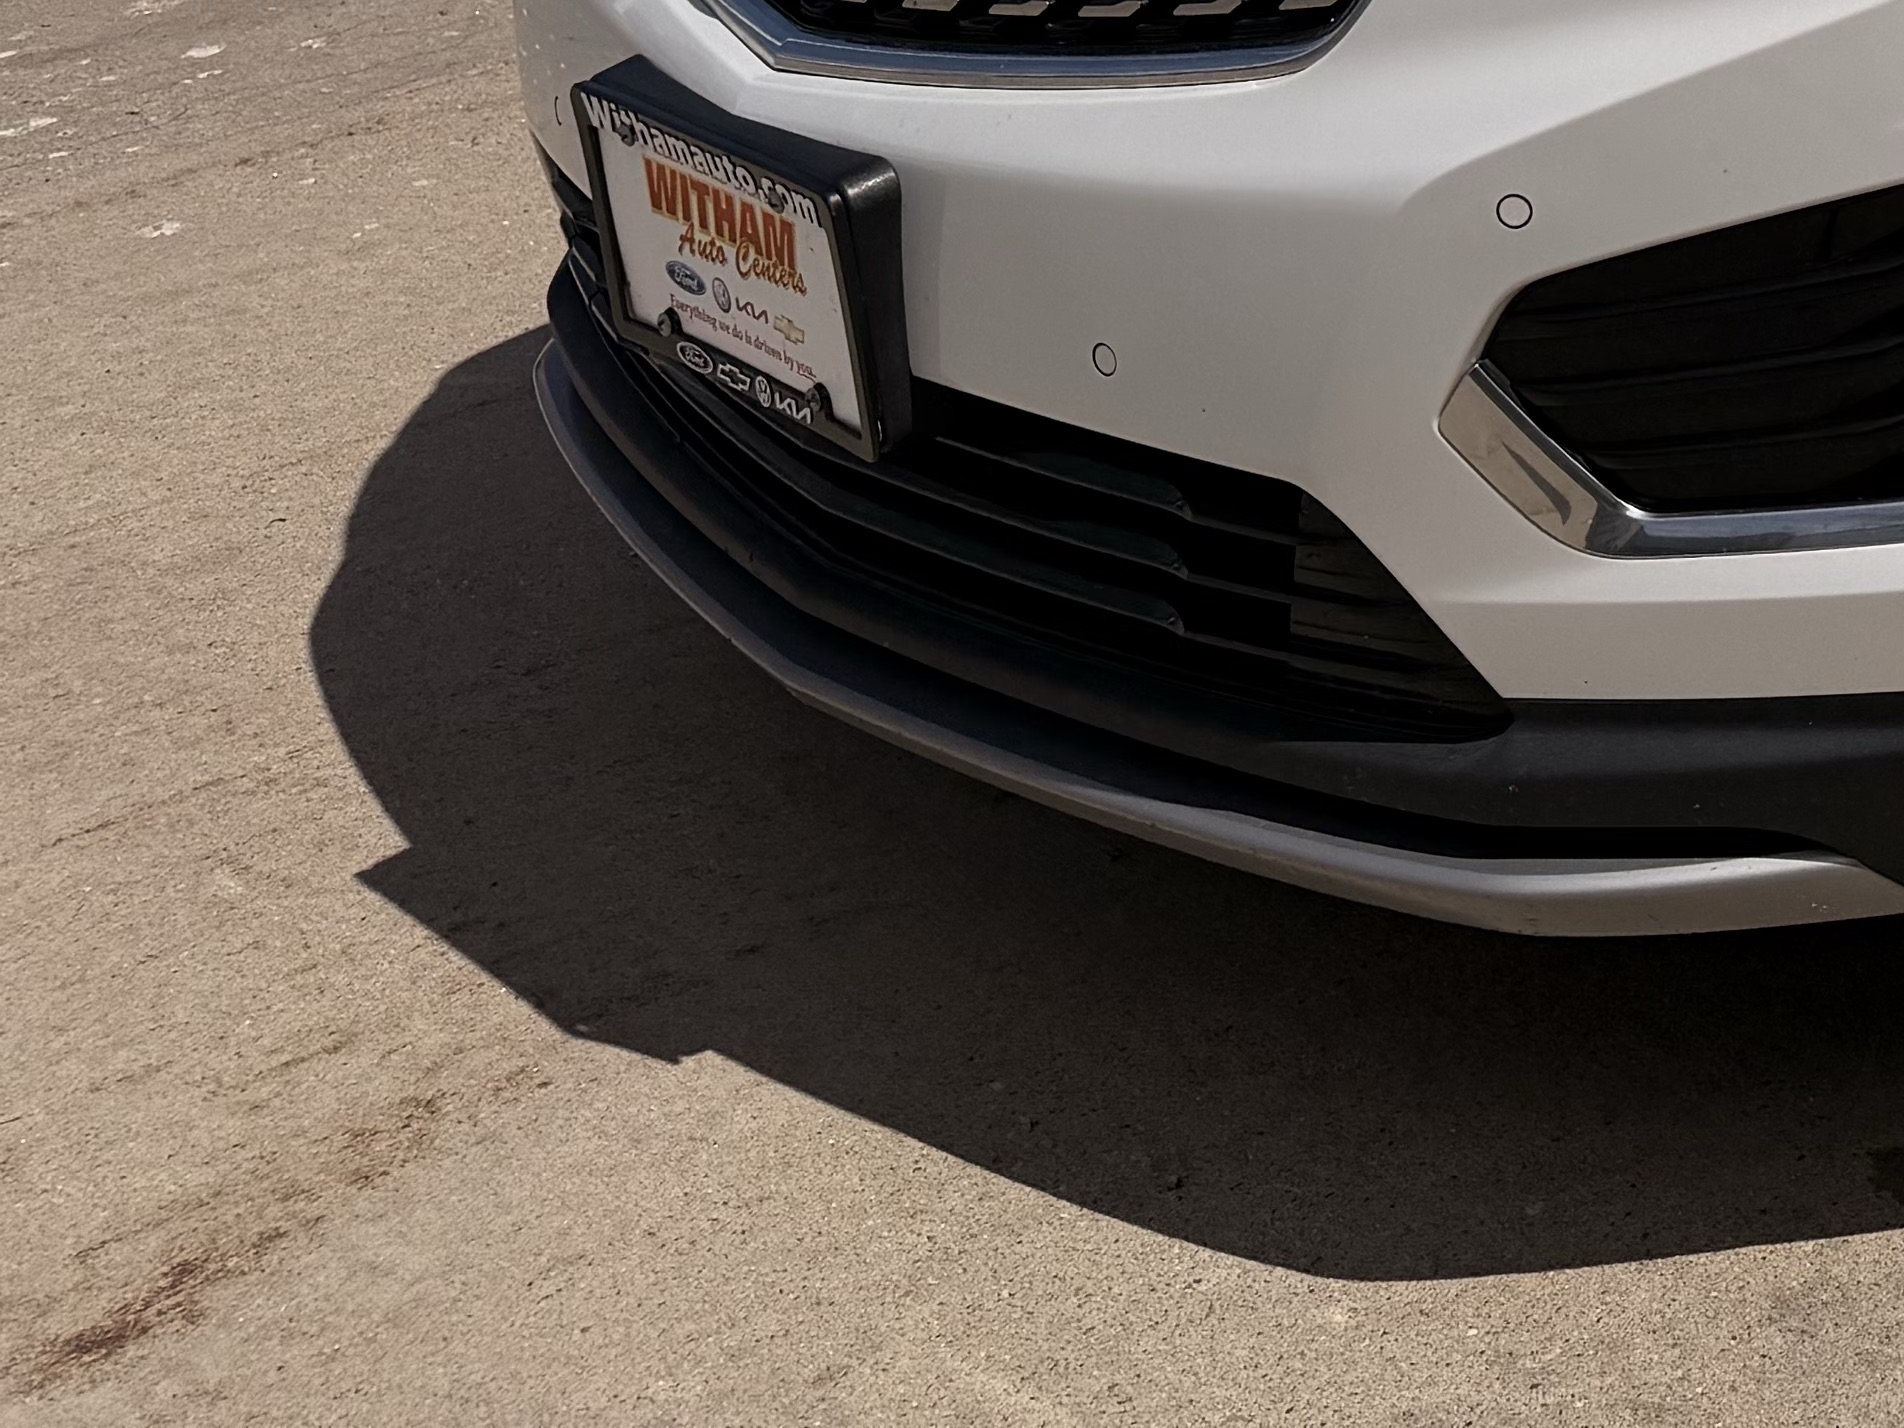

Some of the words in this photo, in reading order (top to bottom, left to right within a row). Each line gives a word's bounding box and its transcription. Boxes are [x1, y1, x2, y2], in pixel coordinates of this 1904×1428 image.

[580, 90, 823, 228] Withamauto.com
[642, 154, 798, 274] WITHAM
[678, 222, 728, 267] Auto
[736, 239, 808, 297] Centers
[670, 294, 718, 332] Everything
[718, 321, 731, 335] we
[731, 324, 744, 342] do
[744, 328, 753, 346] is
[753, 335, 782, 361] driven
[783, 349, 794, 371] by
